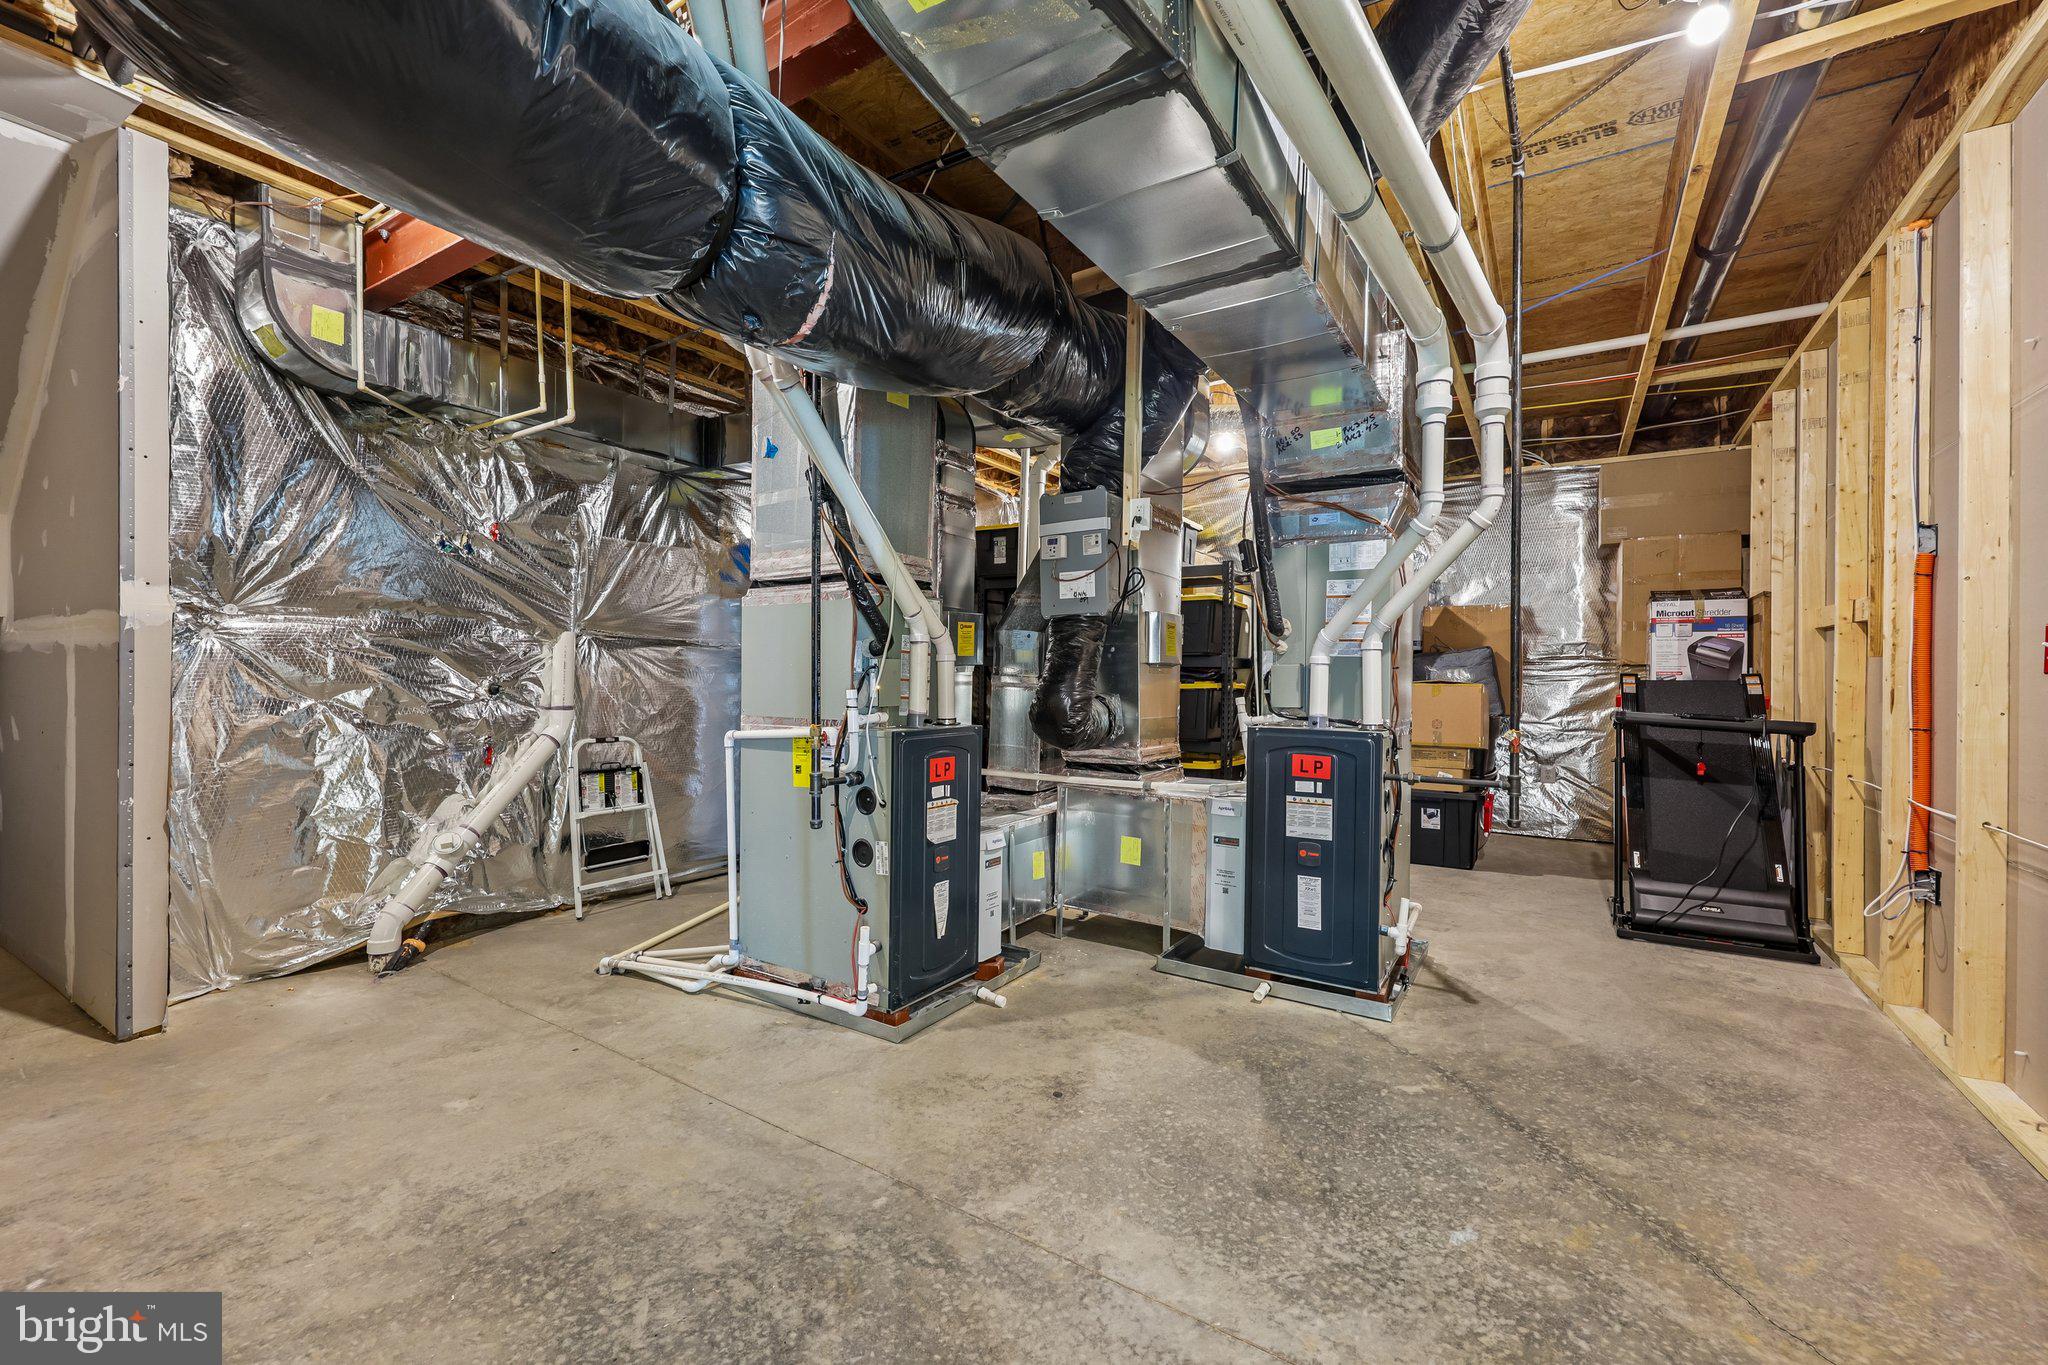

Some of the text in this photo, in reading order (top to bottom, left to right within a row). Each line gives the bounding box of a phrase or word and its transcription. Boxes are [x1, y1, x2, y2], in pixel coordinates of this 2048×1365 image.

[1557, 126, 1618, 150] BLUE
[1656, 608, 1732, 617] Microcut Shredder
